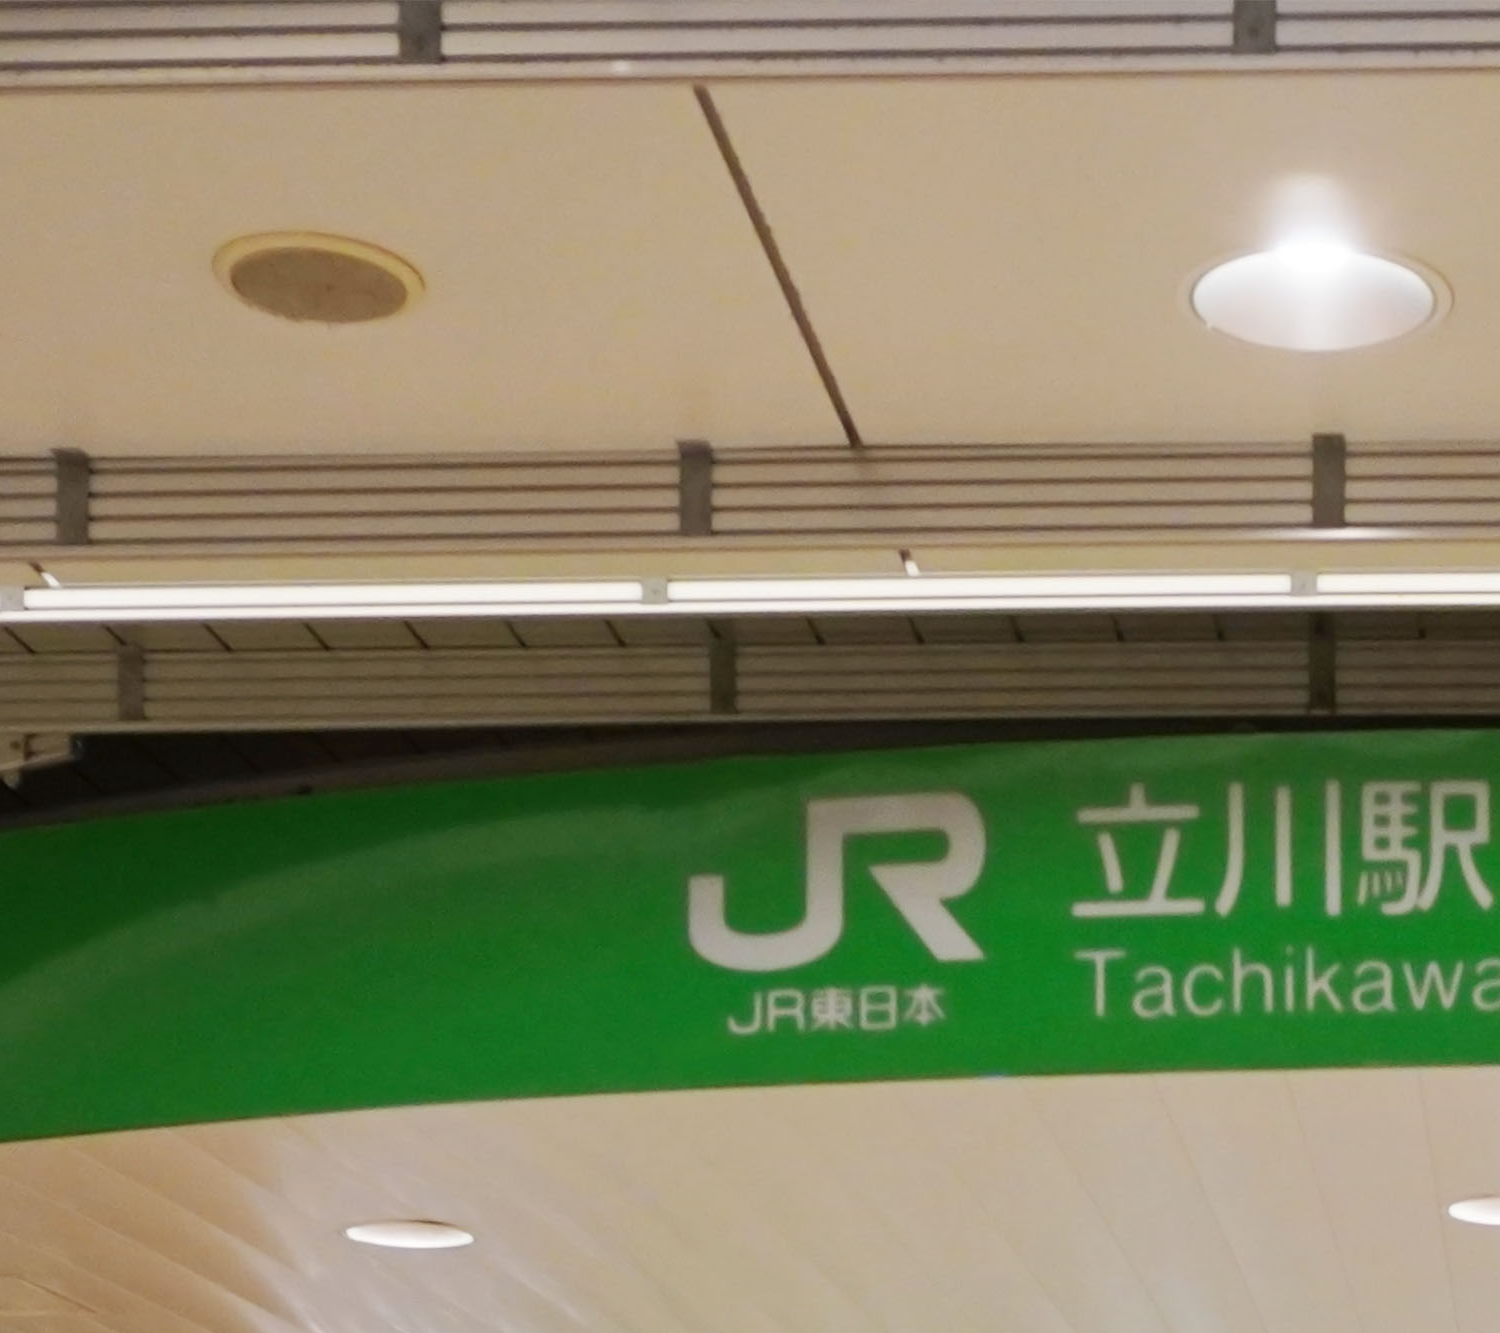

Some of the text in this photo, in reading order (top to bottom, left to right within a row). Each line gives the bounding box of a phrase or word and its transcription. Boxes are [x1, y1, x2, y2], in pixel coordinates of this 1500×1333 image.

[688, 791, 986, 972] JR
[1071, 780, 1494, 916] 立川駅
[727, 983, 945, 1034] JR東日本
